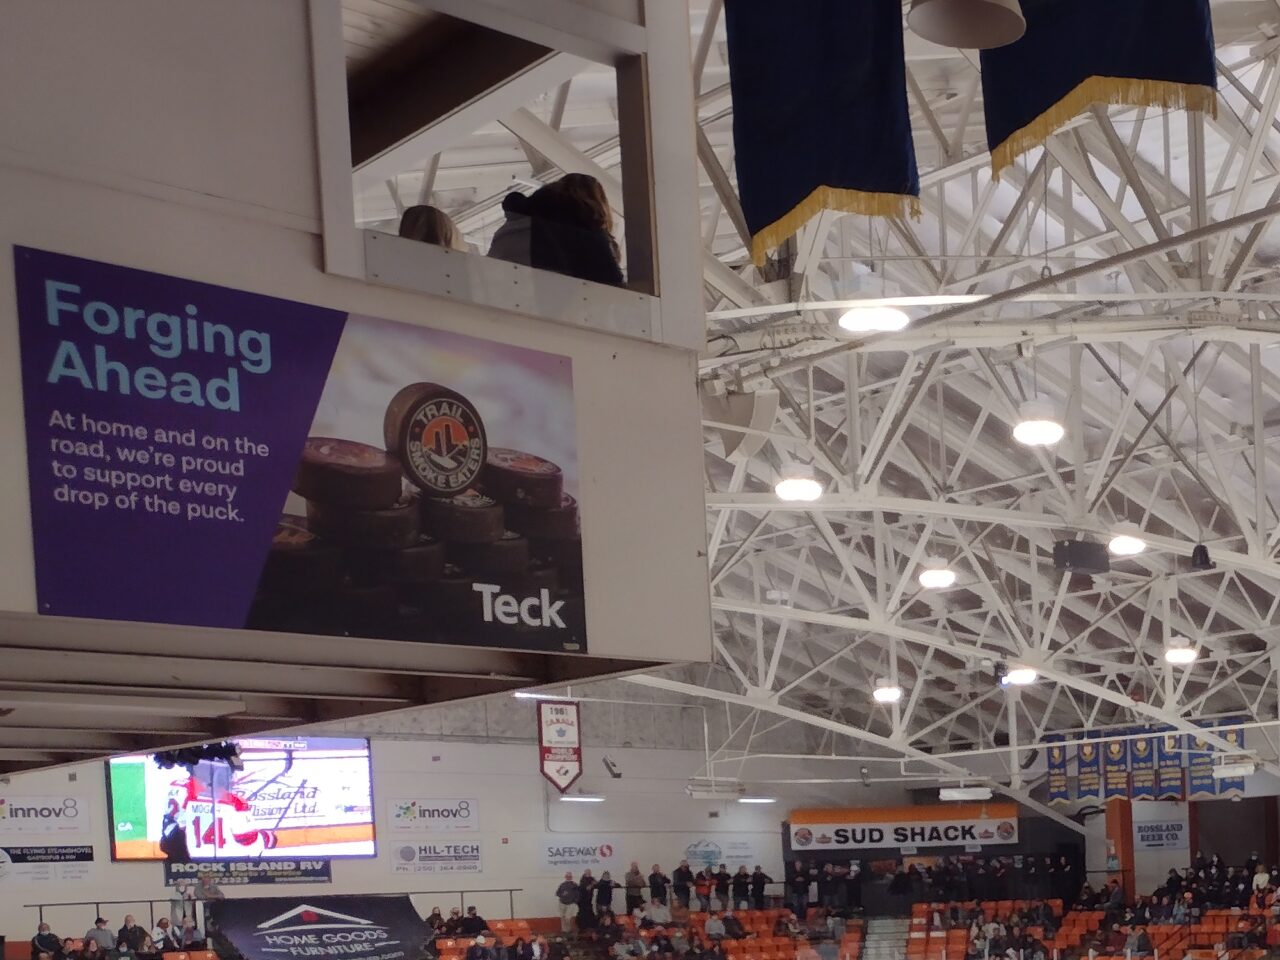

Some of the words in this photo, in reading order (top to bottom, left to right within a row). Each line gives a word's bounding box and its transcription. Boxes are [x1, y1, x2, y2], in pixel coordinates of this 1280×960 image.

[45, 279, 271, 374] Forging
[46, 340, 240, 412] Ahead
[416, 402, 464, 424] TRAIL
[49, 410, 75, 430] At
[82, 413, 148, 440] home
[154, 429, 195, 446] and
[202, 435, 228, 451] on
[235, 436, 270, 457] the
[51, 438, 111, 461] road,
[117, 446, 175, 467] we're
[182, 456, 244, 476] proud
[410, 441, 446, 487] SMOKE
[449, 438, 481, 487] EATERS
[52, 460, 77, 479] to
[84, 466, 172, 491] support
[179, 477, 237, 502] every
[54, 484, 108, 510] drop
[115, 492, 138, 510] of
[144, 494, 180, 514] the
[187, 502, 245, 522] puck.
[472, 582, 567, 628] Teck
[9, 798, 78, 818] innov8
[418, 801, 470, 818] innov8
[192, 816, 226, 849] 14
[834, 828, 884, 844] SUD
[893, 825, 977, 842] SHACK
[418, 845, 479, 854] HIL-TECH
[548, 846, 597, 857] SAFEWAY
[171, 862, 225, 873] ROCK
[229, 861, 296, 872] ISLAND
[300, 861, 323, 870] RV
[266, 935, 320, 946] HOME
[322, 930, 388, 943] GOODS
[289, 942, 375, 957] FURNITURE
